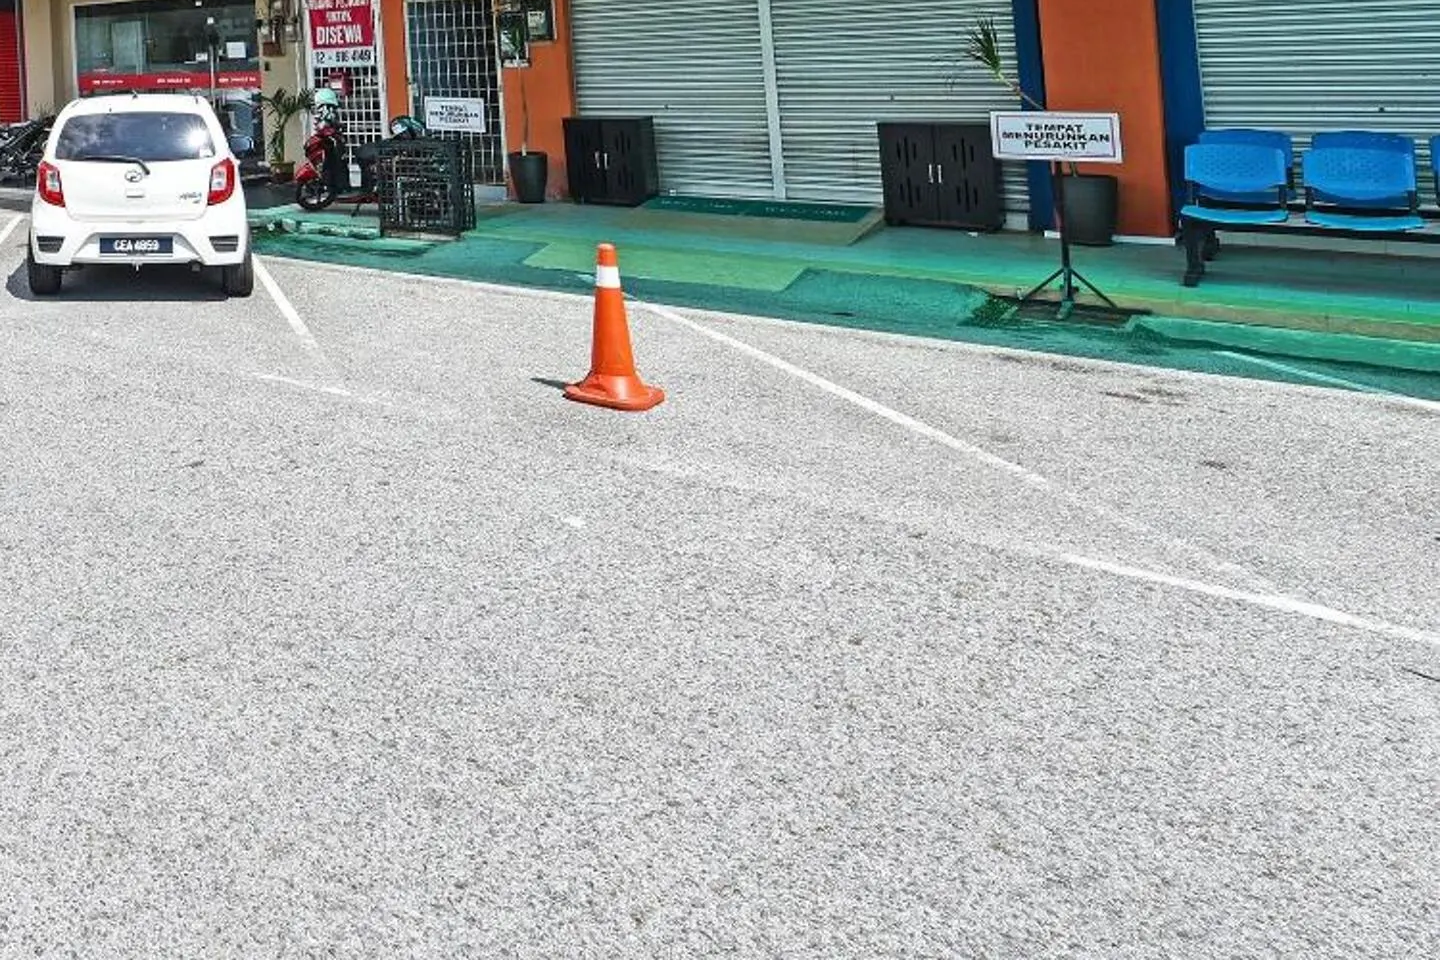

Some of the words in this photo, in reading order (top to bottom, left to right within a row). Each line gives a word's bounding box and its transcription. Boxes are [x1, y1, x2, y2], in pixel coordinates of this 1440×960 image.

[316, 24, 363, 45] DISEWA
[1025, 123, 1083, 132] TEMPAT
[1002, 132, 1110, 143] MENURUNKAN
[1024, 141, 1088, 150] PESAKIT
